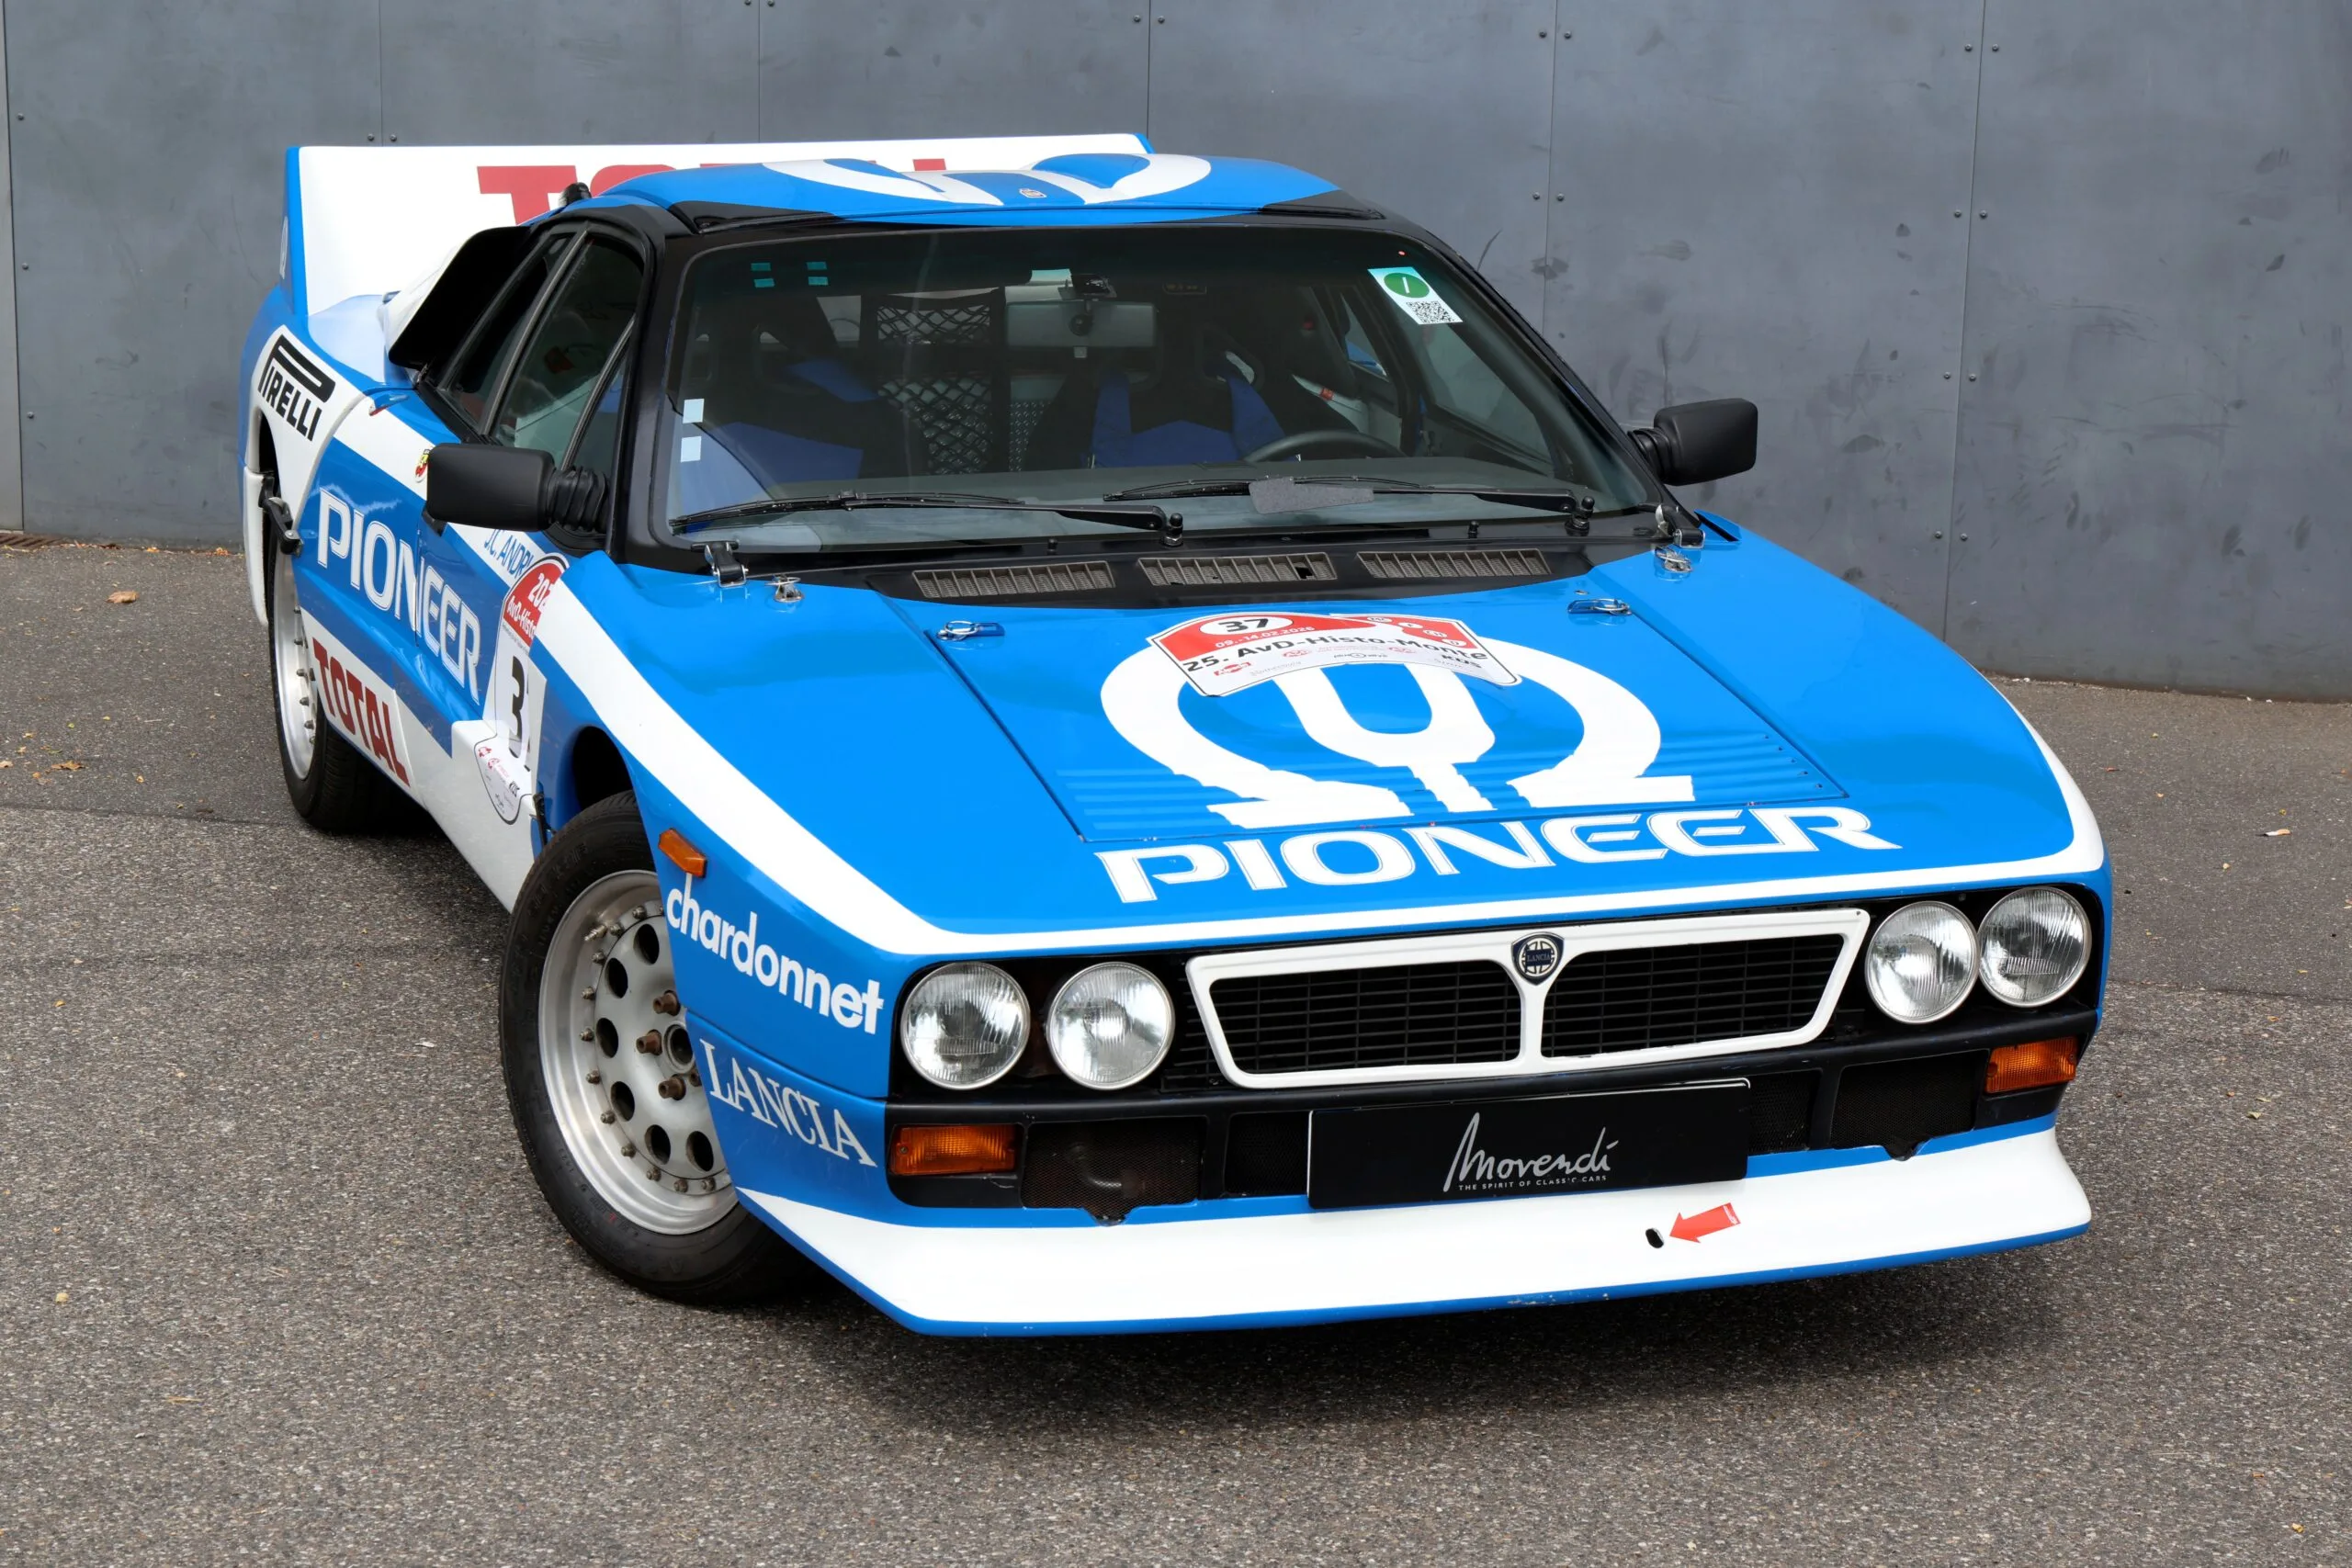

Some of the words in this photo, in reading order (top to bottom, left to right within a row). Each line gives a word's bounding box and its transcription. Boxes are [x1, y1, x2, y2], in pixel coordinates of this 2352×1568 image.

[257, 333, 335, 442] PIRELLI
[318, 488, 480, 705] PIONEER
[1218, 618, 1269, 633] 37
[1182, 655, 1228, 671] 25.
[1238, 635, 1487, 660] AvD-Histo-Monte
[312, 637, 410, 787] TOTAL
[1097, 806, 1902, 903] PIONEER
[666, 872, 885, 1034] chardonnet
[1527, 953, 1551, 963] LANCIA
[699, 1038, 878, 1168] LANCIA
[1458, 1183, 1477, 1191] THE
[1482, 1180, 1515, 1190] SPIRIT
[1581, 1174, 1608, 1183] CARS
